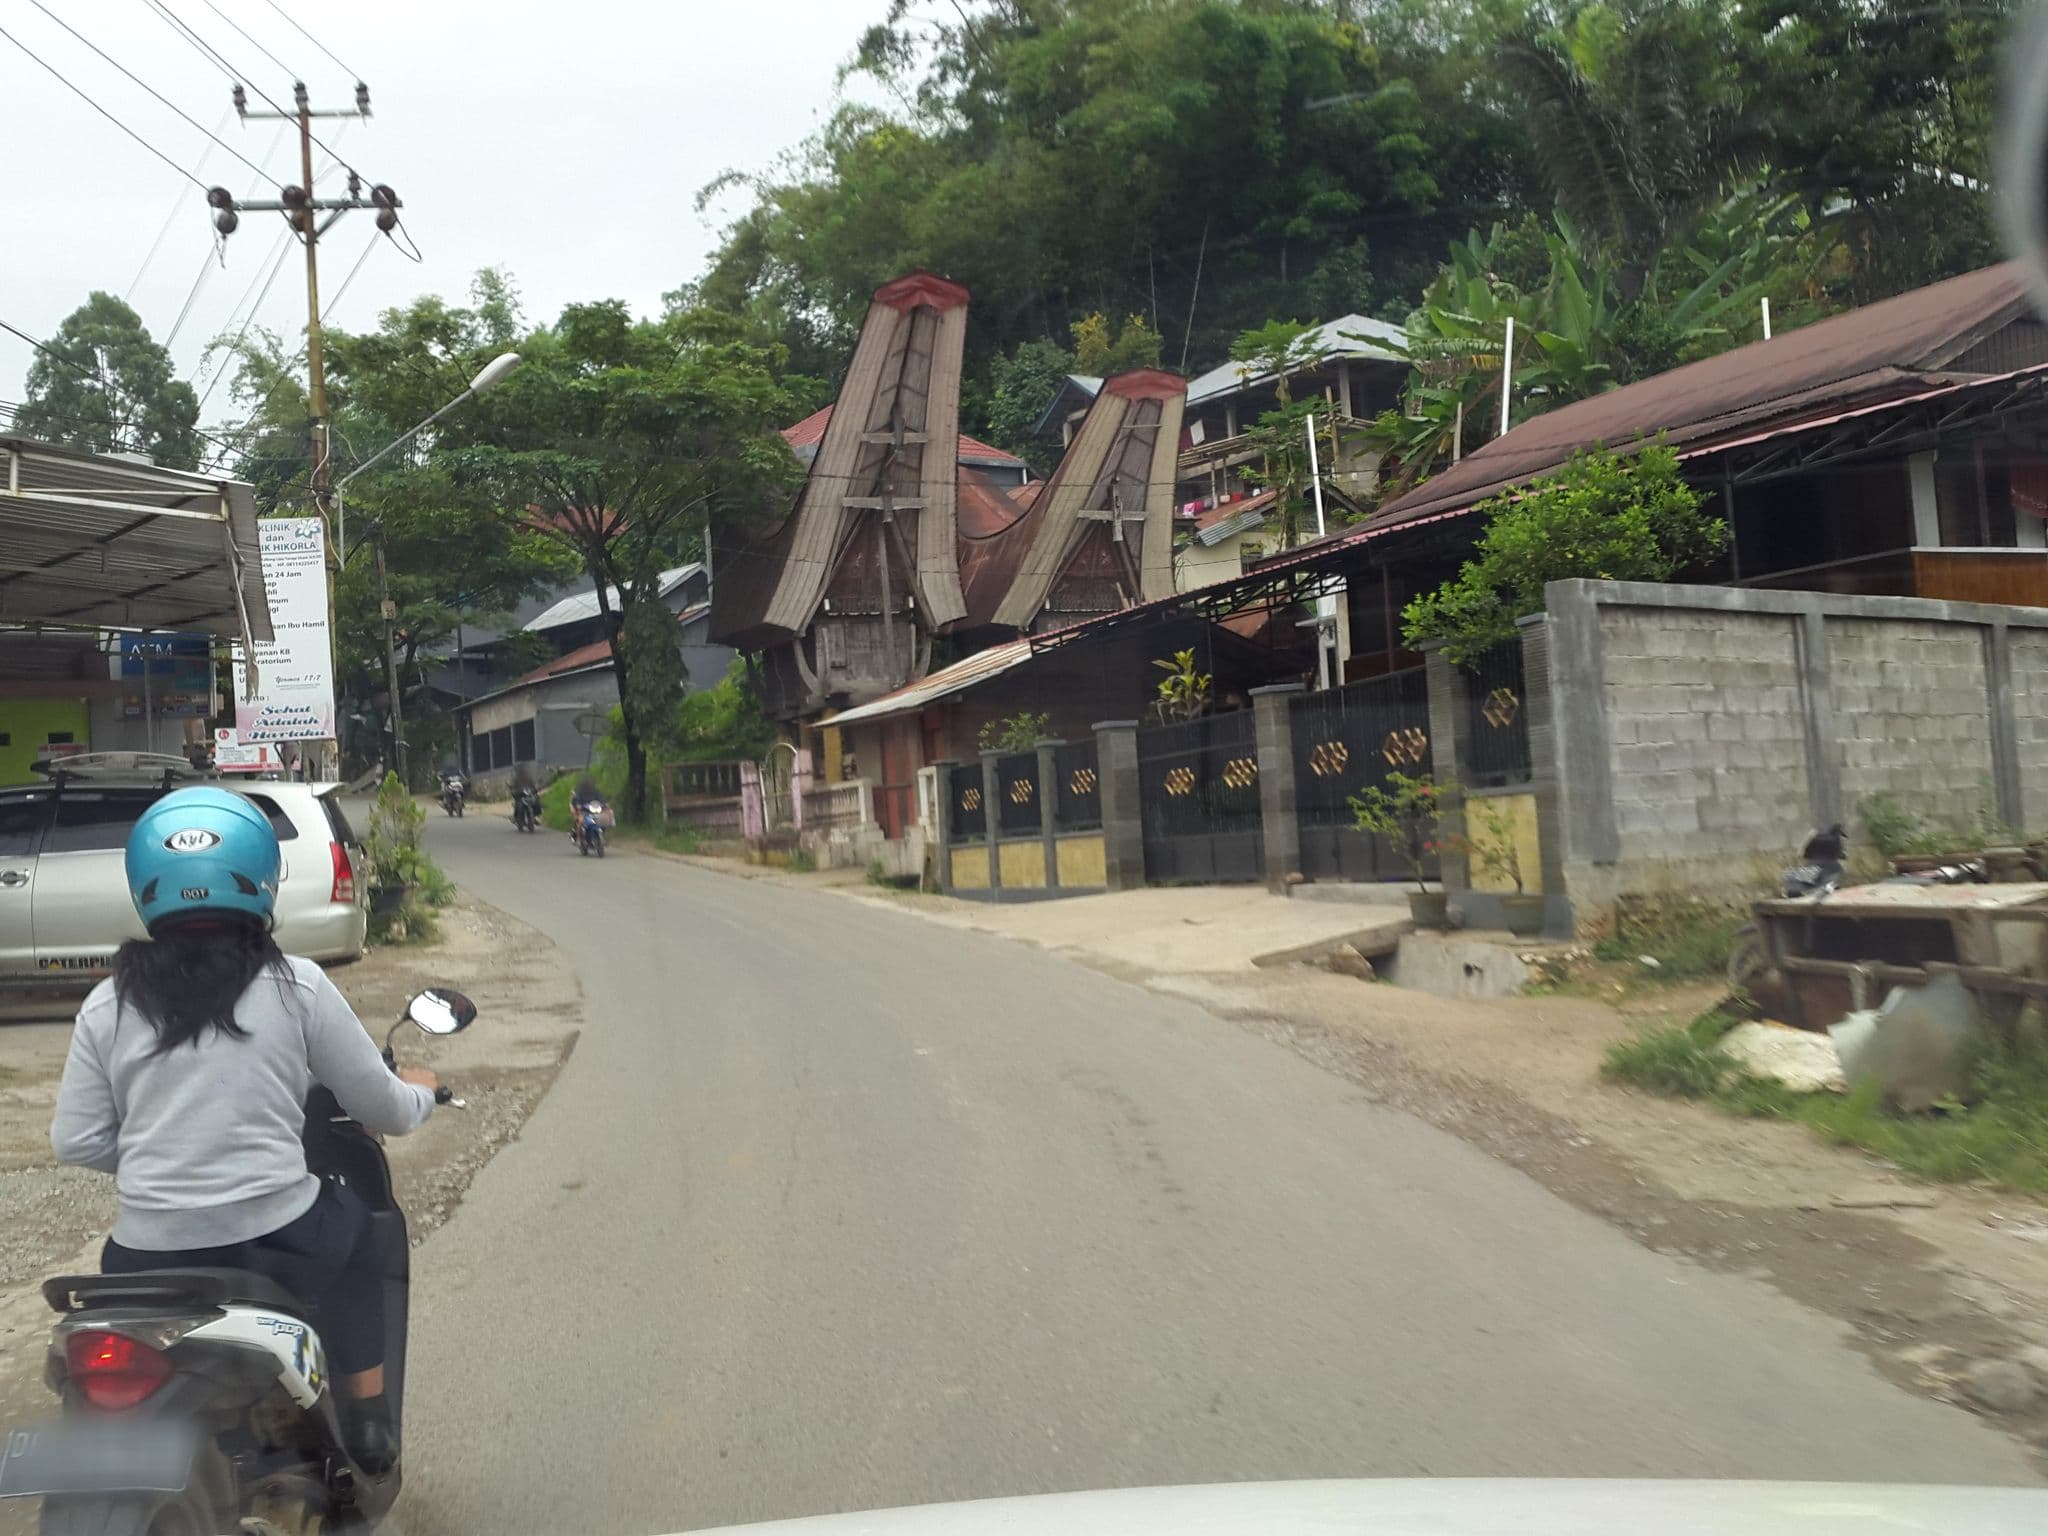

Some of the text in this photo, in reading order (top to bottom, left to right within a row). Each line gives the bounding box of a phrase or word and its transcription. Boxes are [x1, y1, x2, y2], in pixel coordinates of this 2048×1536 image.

[265, 534, 284, 542] dan
[273, 541, 316, 551] HIKORLA
[261, 705, 311, 715] Sehat
[254, 716, 318, 726] Adalah
[248, 728, 325, 740] Hartaku
